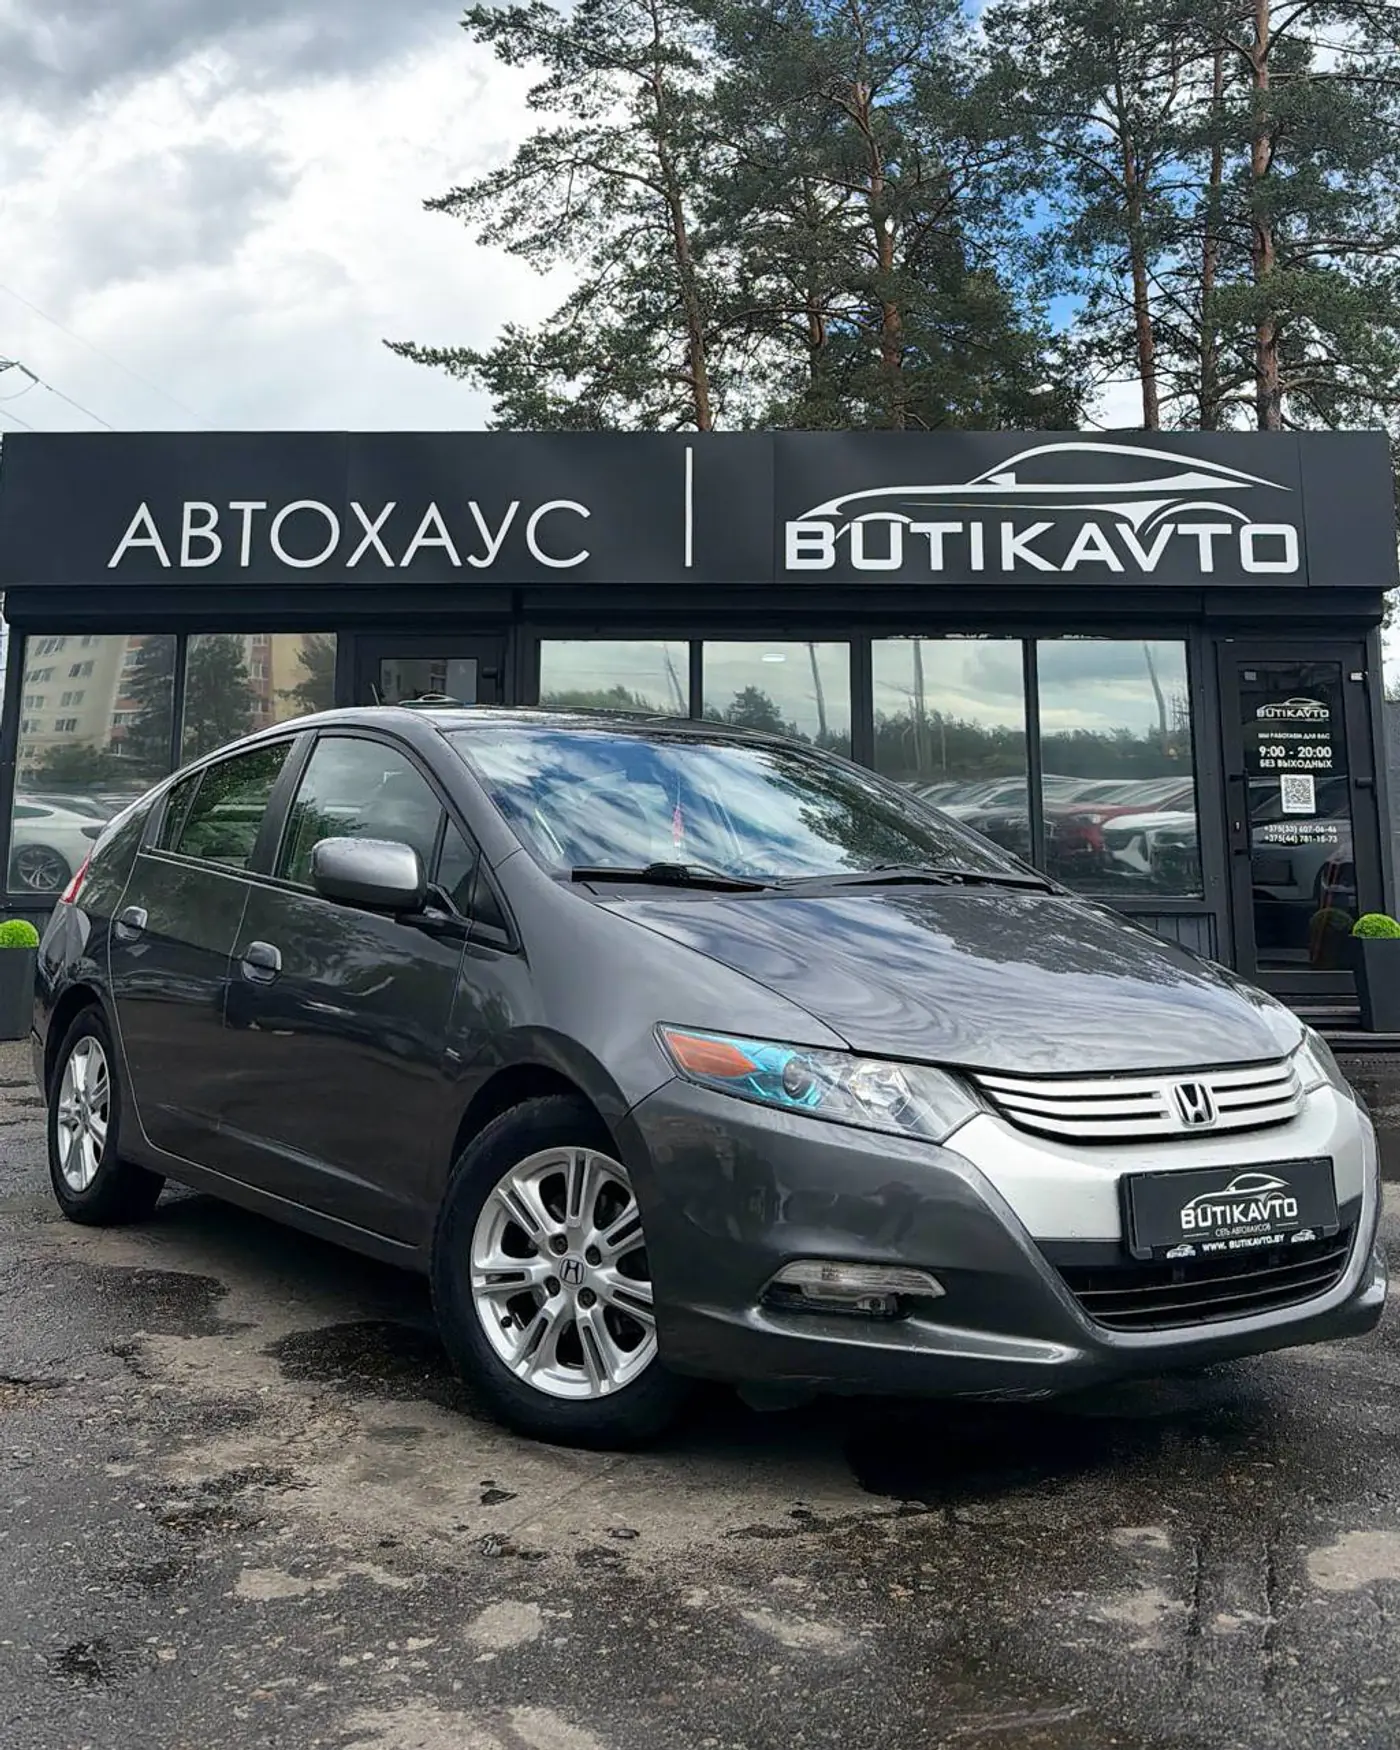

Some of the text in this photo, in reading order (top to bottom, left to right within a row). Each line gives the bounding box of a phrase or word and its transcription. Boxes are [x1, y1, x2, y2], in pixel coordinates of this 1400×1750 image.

[108, 500, 591, 568] АВТОХАУС
[785, 521, 1299, 573] BUTIKAVTO
[1256, 709, 1329, 718] BUTIKAVTO
[1259, 746, 1285, 757] 9:00
[1297, 746, 1332, 758] 20:00
[1259, 759, 1332, 769] БЕЗ ВЫХОДНЫХ
[1180, 1198, 1298, 1229] BUTIKAVTO
